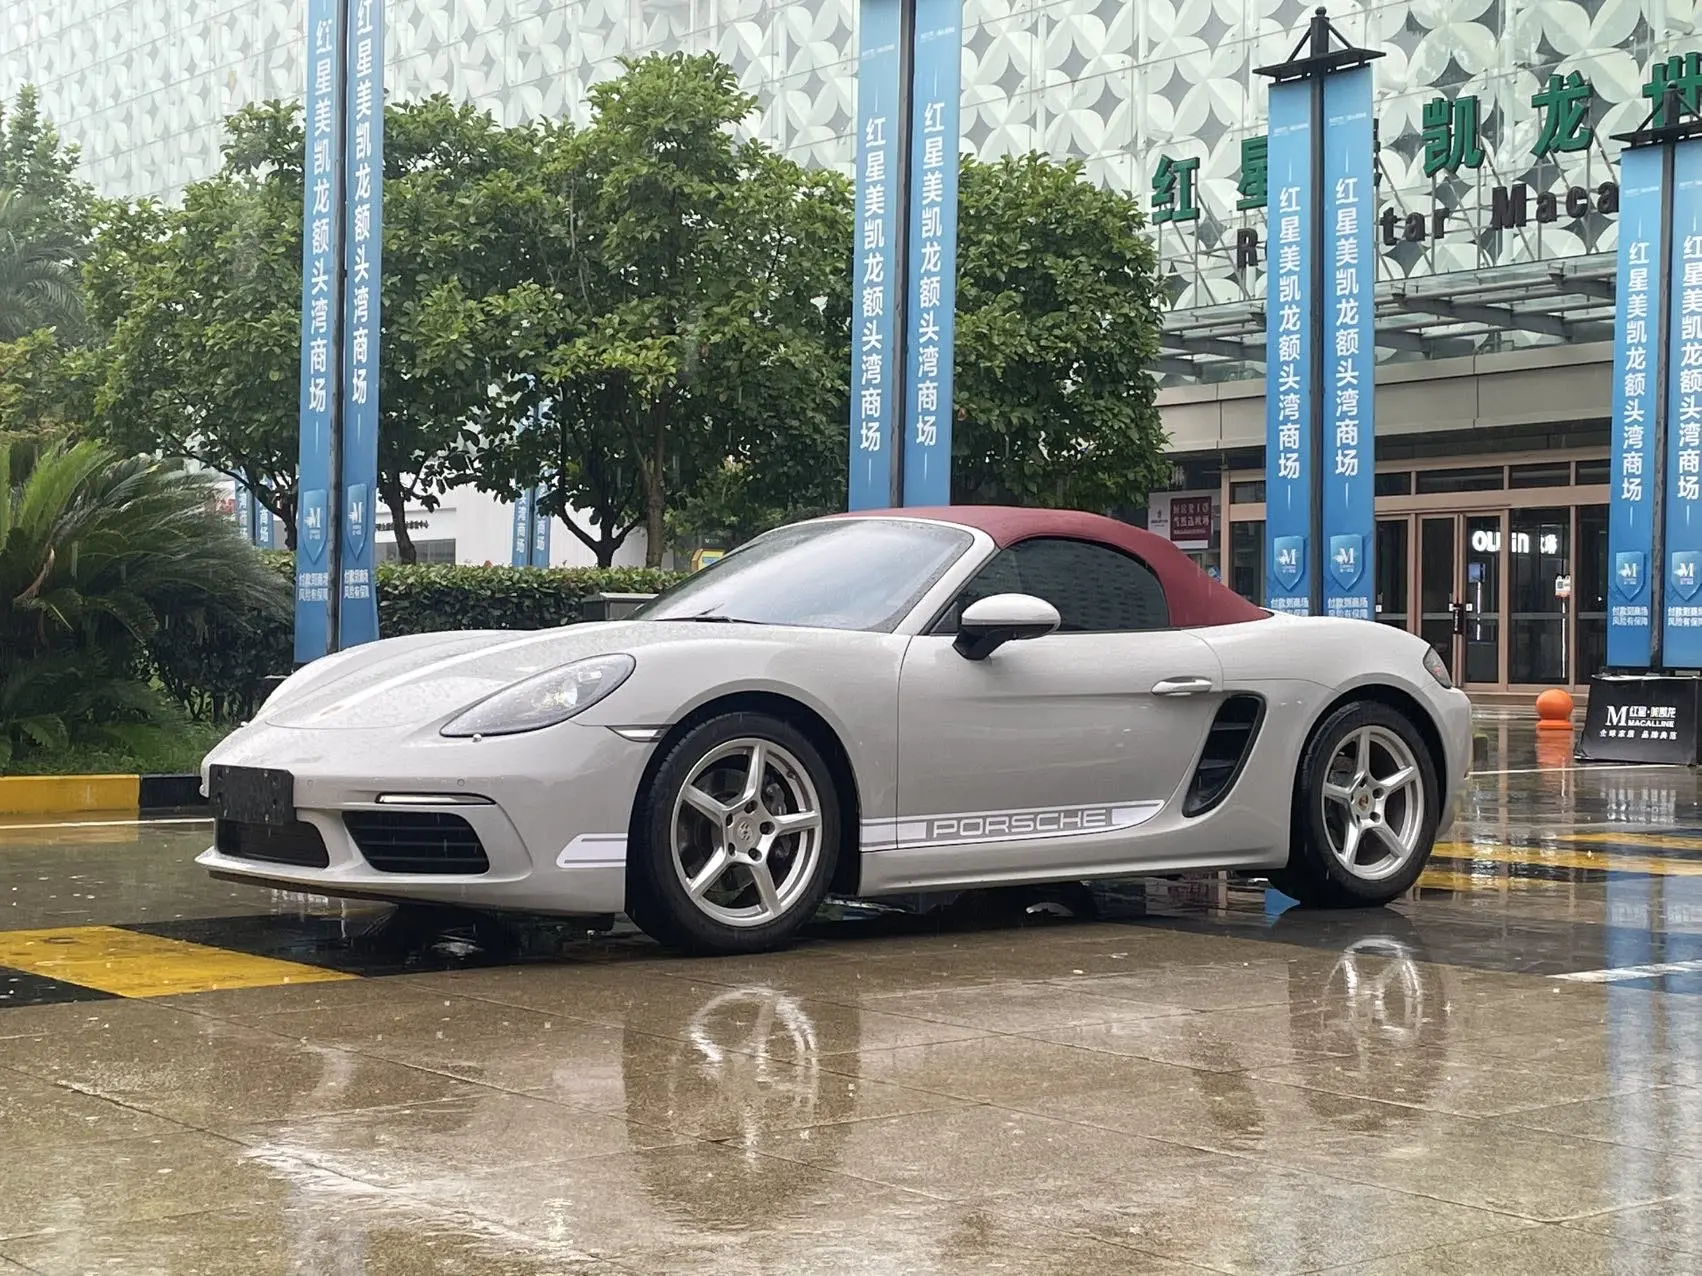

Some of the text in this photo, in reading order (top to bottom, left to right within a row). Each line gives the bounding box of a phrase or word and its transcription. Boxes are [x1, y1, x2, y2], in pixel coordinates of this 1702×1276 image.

[309, 19, 332, 412] 红星美凯龙额头湾商场
[352, 0, 373, 404] 红星美凯龙额头湾商场
[860, 117, 886, 451] 红星美凯龙额头湾商场
[916, 103, 944, 446] 红星美凯龙额头湾商场
[1278, 186, 1300, 480] 红星美凯龙额头湾商场
[1335, 177, 1358, 477] 红星美凯龙额头湾商场
[1622, 242, 1650, 501] 红星美凯龙额头湾商场
[1678, 235, 1702, 500] 红星美凯龙额头湾商场
[932, 808, 1107, 839] PORSCHE
[1605, 705, 1628, 727] M
